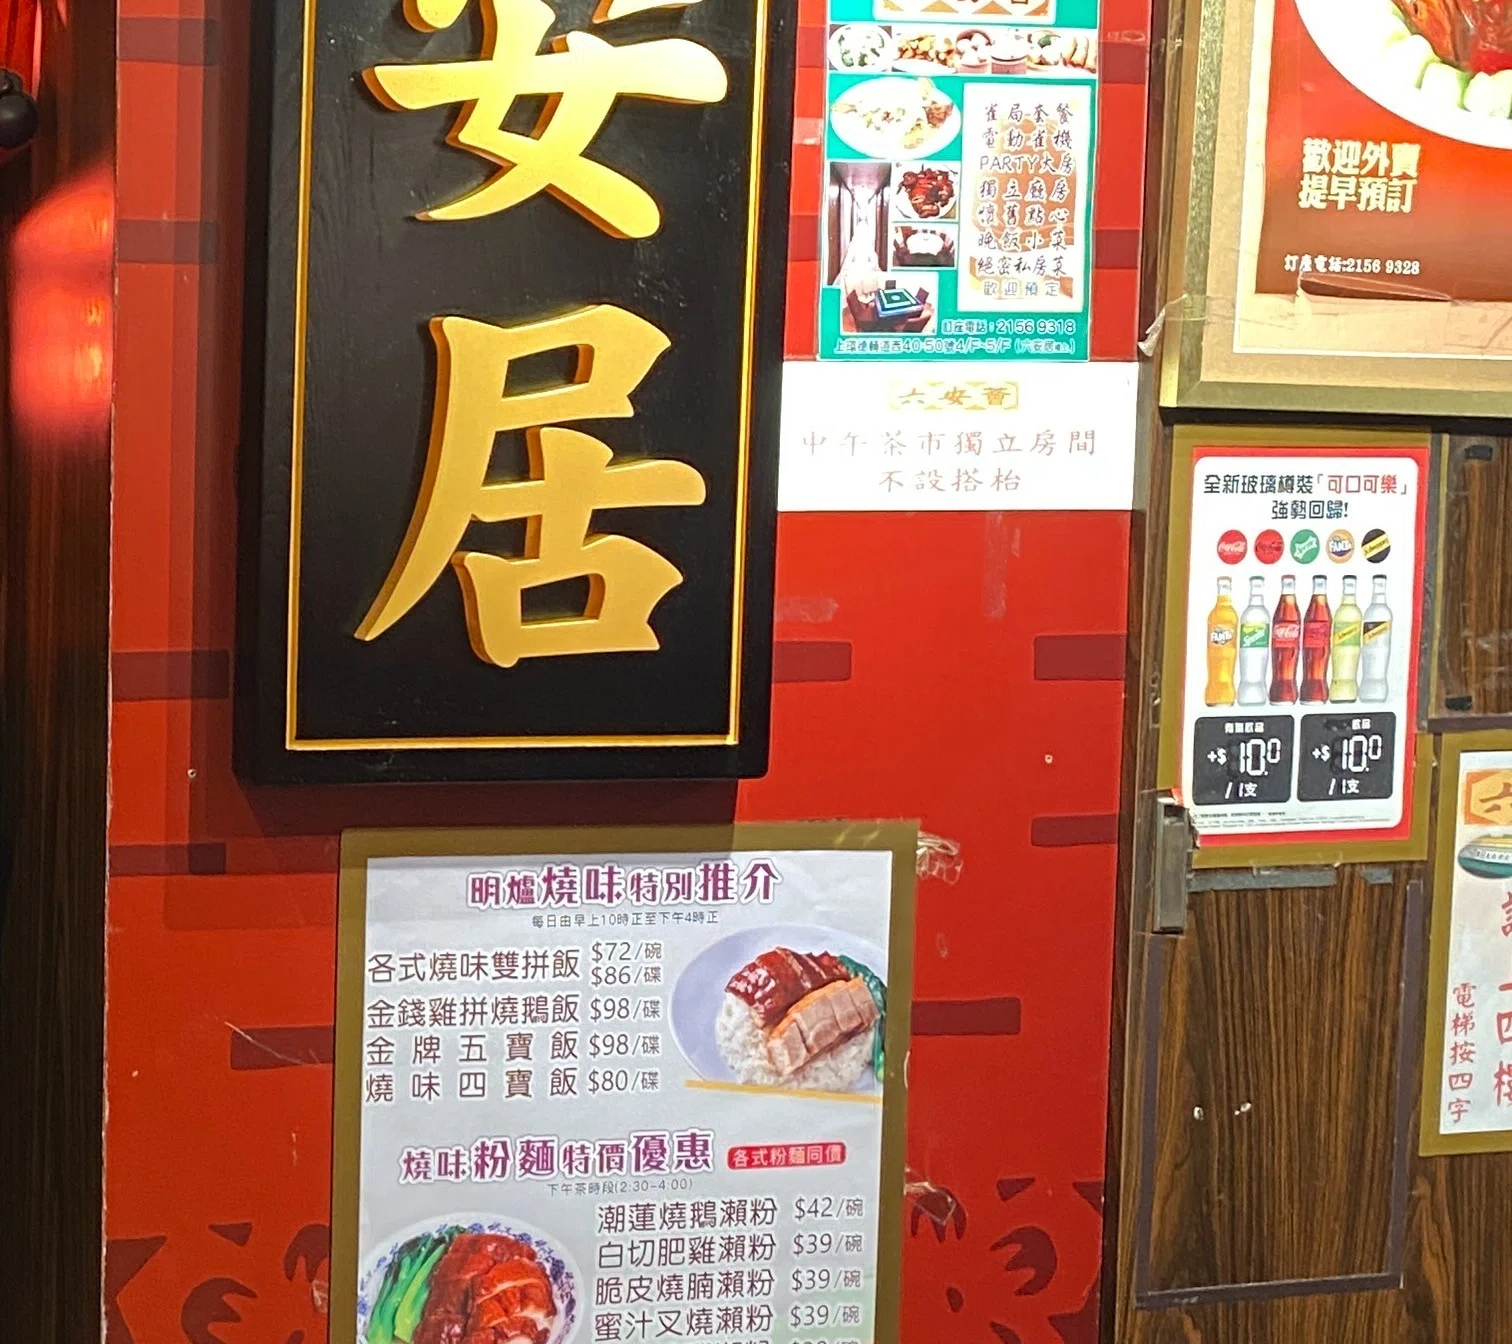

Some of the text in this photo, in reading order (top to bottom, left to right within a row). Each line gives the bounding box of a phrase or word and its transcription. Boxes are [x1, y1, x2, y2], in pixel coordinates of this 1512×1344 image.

[1303, 138, 1421, 178] 歡迎外賣
[1298, 174, 1418, 213] 提早預訂
[1385, 259, 1420, 275] 9328
[1037, 320, 1075, 334] 9318
[899, 386, 1012, 407] 六安薈
[802, 428, 1096, 457] 中午茶市獨立房間
[878, 467, 1021, 493] 不設搭枱
[1271, 499, 1349, 520] 強勢回歸!
[469, 862, 779, 907] 明爐燒味特別推介
[531, 911, 719, 929] 每日由早上10時正至下午4時正
[368, 949, 580, 983] 各式燒味雙拼飯
[591, 942, 662, 962] $72/碗
[590, 965, 662, 986] $86/碟
[366, 993, 660, 1029] 金錢雞拼燒鵝飯 $98/碟
[366, 1030, 660, 1066] 金牌五寶飯 $98/碟
[1448, 982, 1476, 1124] 電梯按四字
[365, 1066, 659, 1103] 燒味四寶飯 $80/碟
[400, 1131, 714, 1183] 燒味粉麵特價優惠
[731, 1145, 845, 1168] 各式粉麵同價
[597, 1196, 863, 1233] 潮蓮燒鵝瀨粉 $42/碗
[597, 1232, 862, 1269] 白切肥雞瀨粉 $39/碗
[595, 1268, 861, 1306] 脆皮燒腩瀨粉 $39/碗
[594, 1304, 860, 1342] 蜜汁叉燒瀨粉 $39/碗
